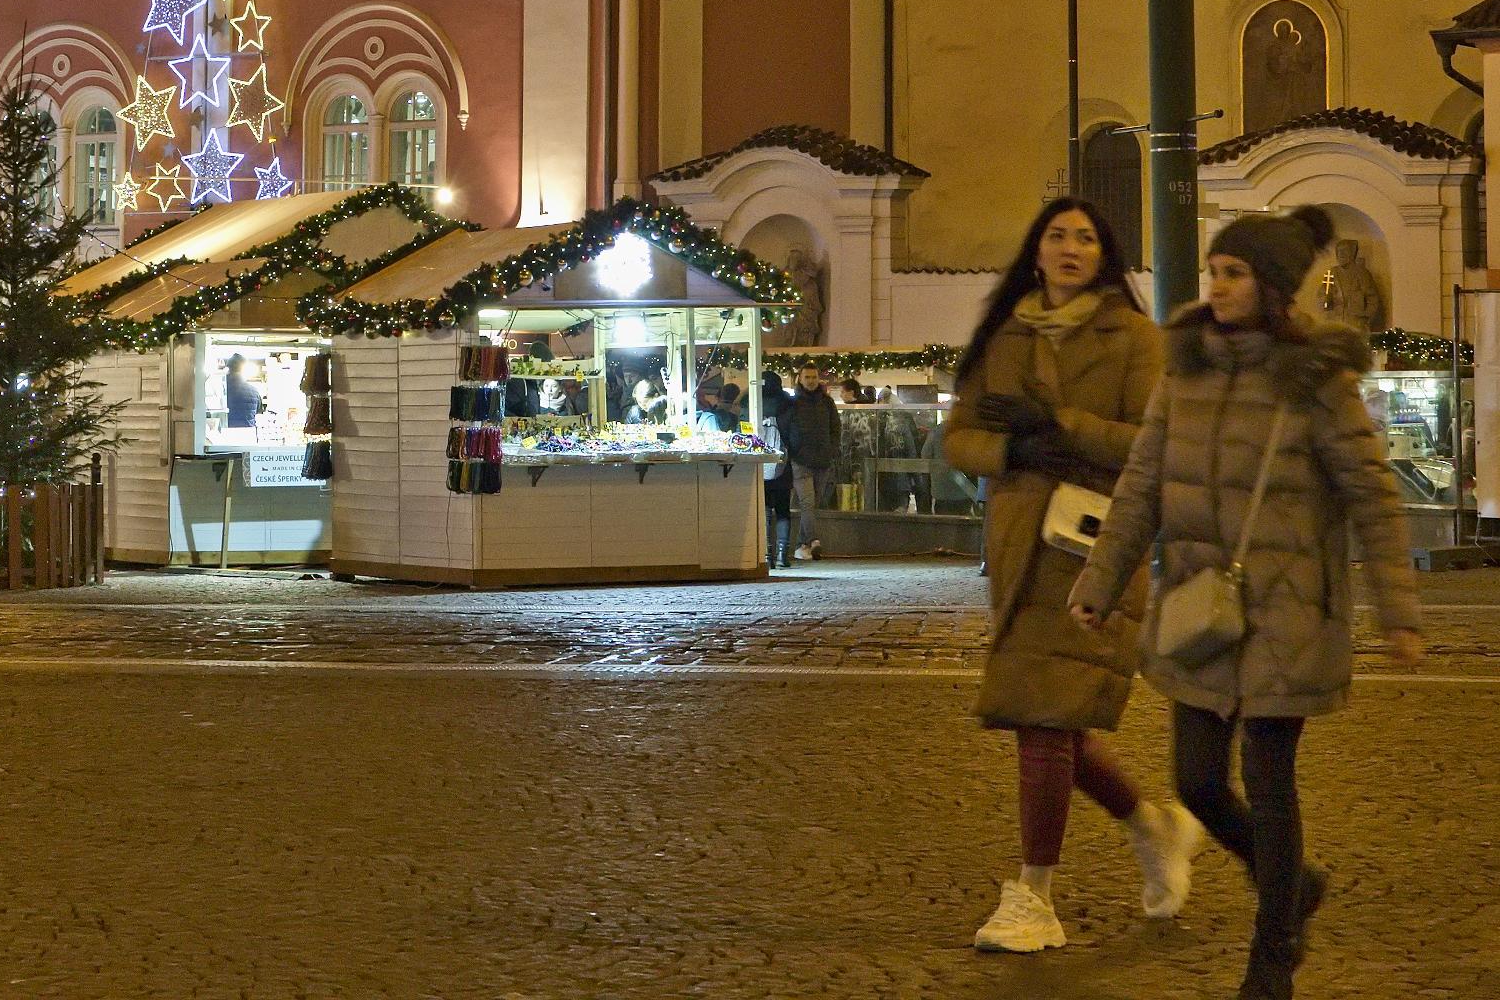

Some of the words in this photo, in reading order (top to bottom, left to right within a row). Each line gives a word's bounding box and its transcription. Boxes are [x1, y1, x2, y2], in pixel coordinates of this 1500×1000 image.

[275, 454, 305, 462] JEWELLE
[256, 474, 277, 483] ČESKÉ
[278, 474, 303, 483] ŠPERKY
